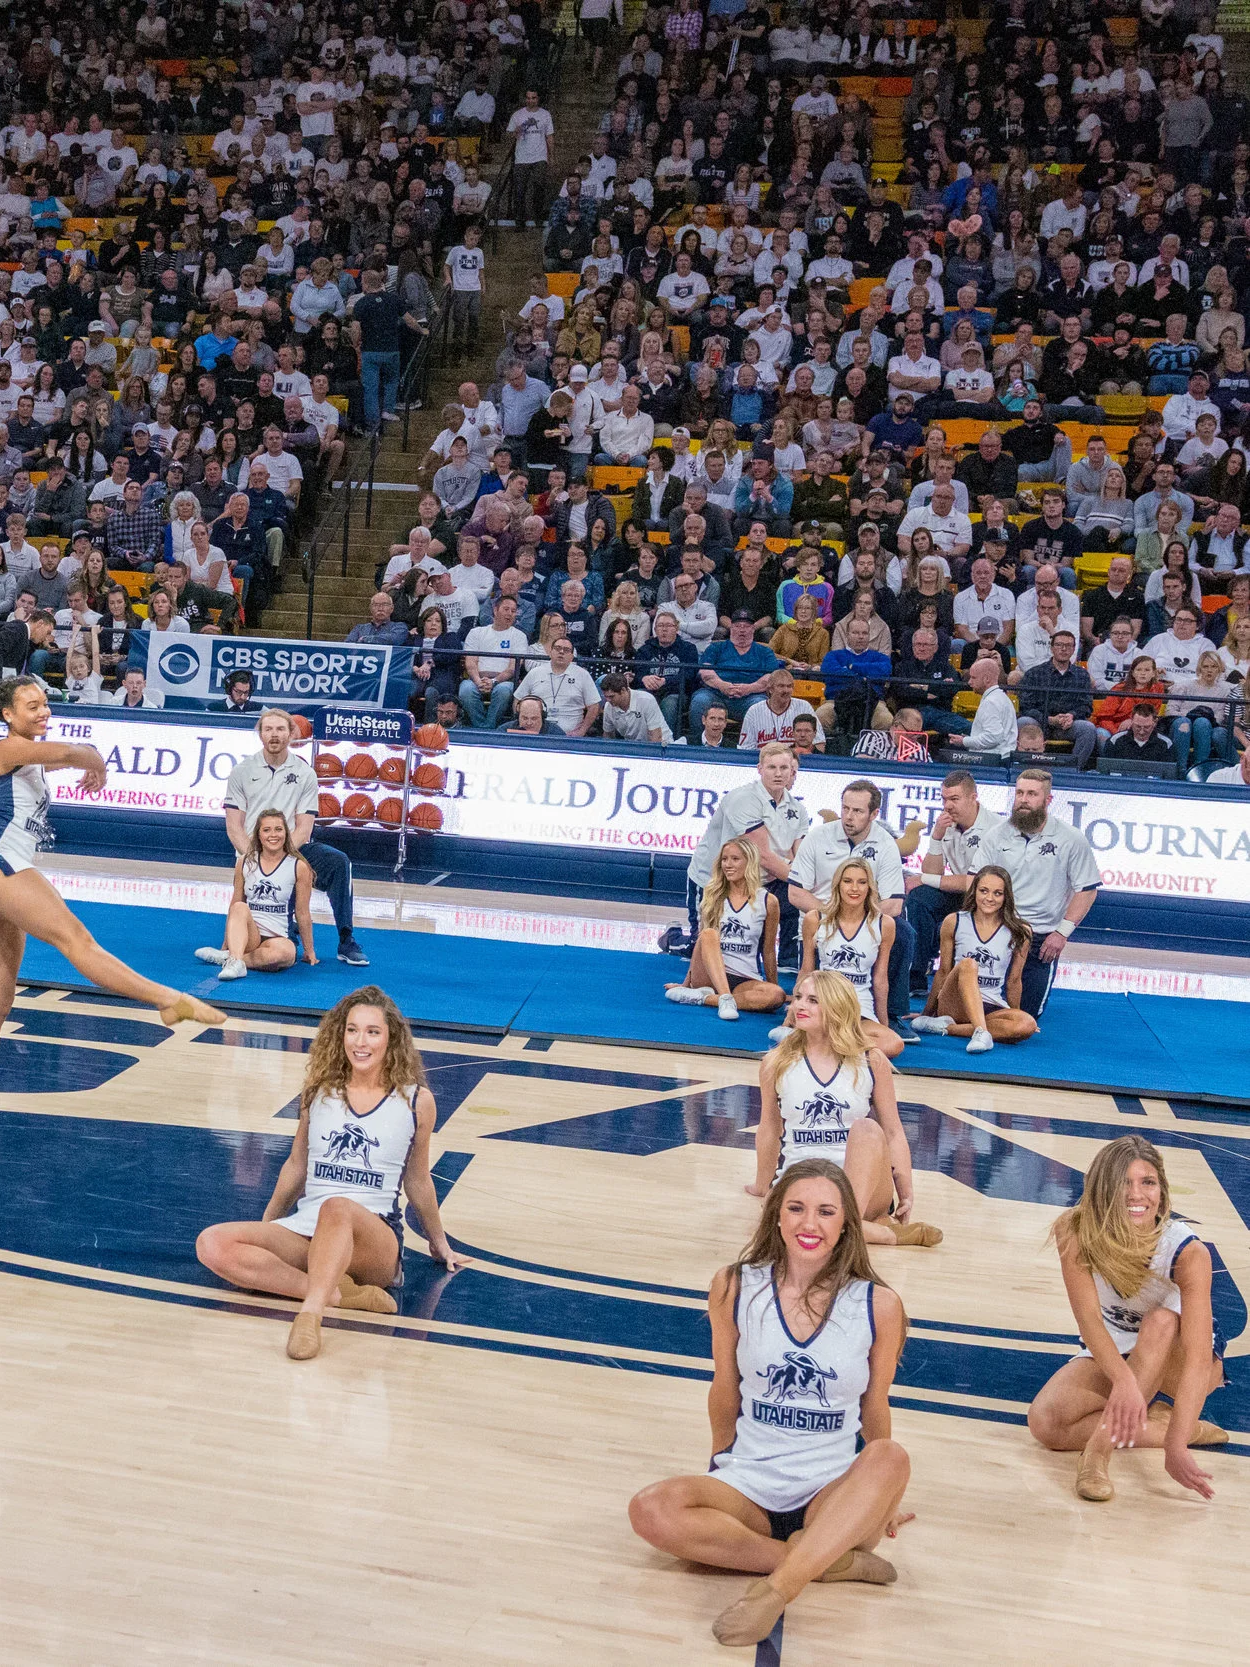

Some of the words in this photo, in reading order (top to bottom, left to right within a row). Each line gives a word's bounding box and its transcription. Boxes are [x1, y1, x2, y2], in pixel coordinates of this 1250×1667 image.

[1033, 545, 1063, 556] STATE
[217, 646, 268, 669] CBS
[274, 649, 378, 674] SPORTS
[216, 668, 350, 694] NTWORK
[59, 723, 92, 738] THE
[325, 714, 400, 730] UtahState
[325, 726, 401, 739] BASKETBALL
[757, 727, 778, 743] Mud
[778, 726, 794, 738] He
[105, 745, 181, 776] ALD
[56, 785, 167, 808] EMPOWERING
[171, 794, 204, 810] THE
[606, 767, 719, 820] JOUR
[902, 784, 943, 802] THE
[589, 827, 623, 844] THE
[627, 830, 701, 851] COMMU
[1067, 801, 1250, 862] JOURNA
[264, 904, 286, 914] STATE
[731, 943, 752, 954] STATE
[978, 976, 1000, 986] STATE
[792, 1129, 823, 1144] UTAH
[824, 1129, 850, 1144] STA
[314, 1161, 343, 1183] UTAH
[344, 1167, 384, 1190] STATE
[752, 1399, 794, 1427] UTAH
[794, 1408, 846, 1432] STATE
